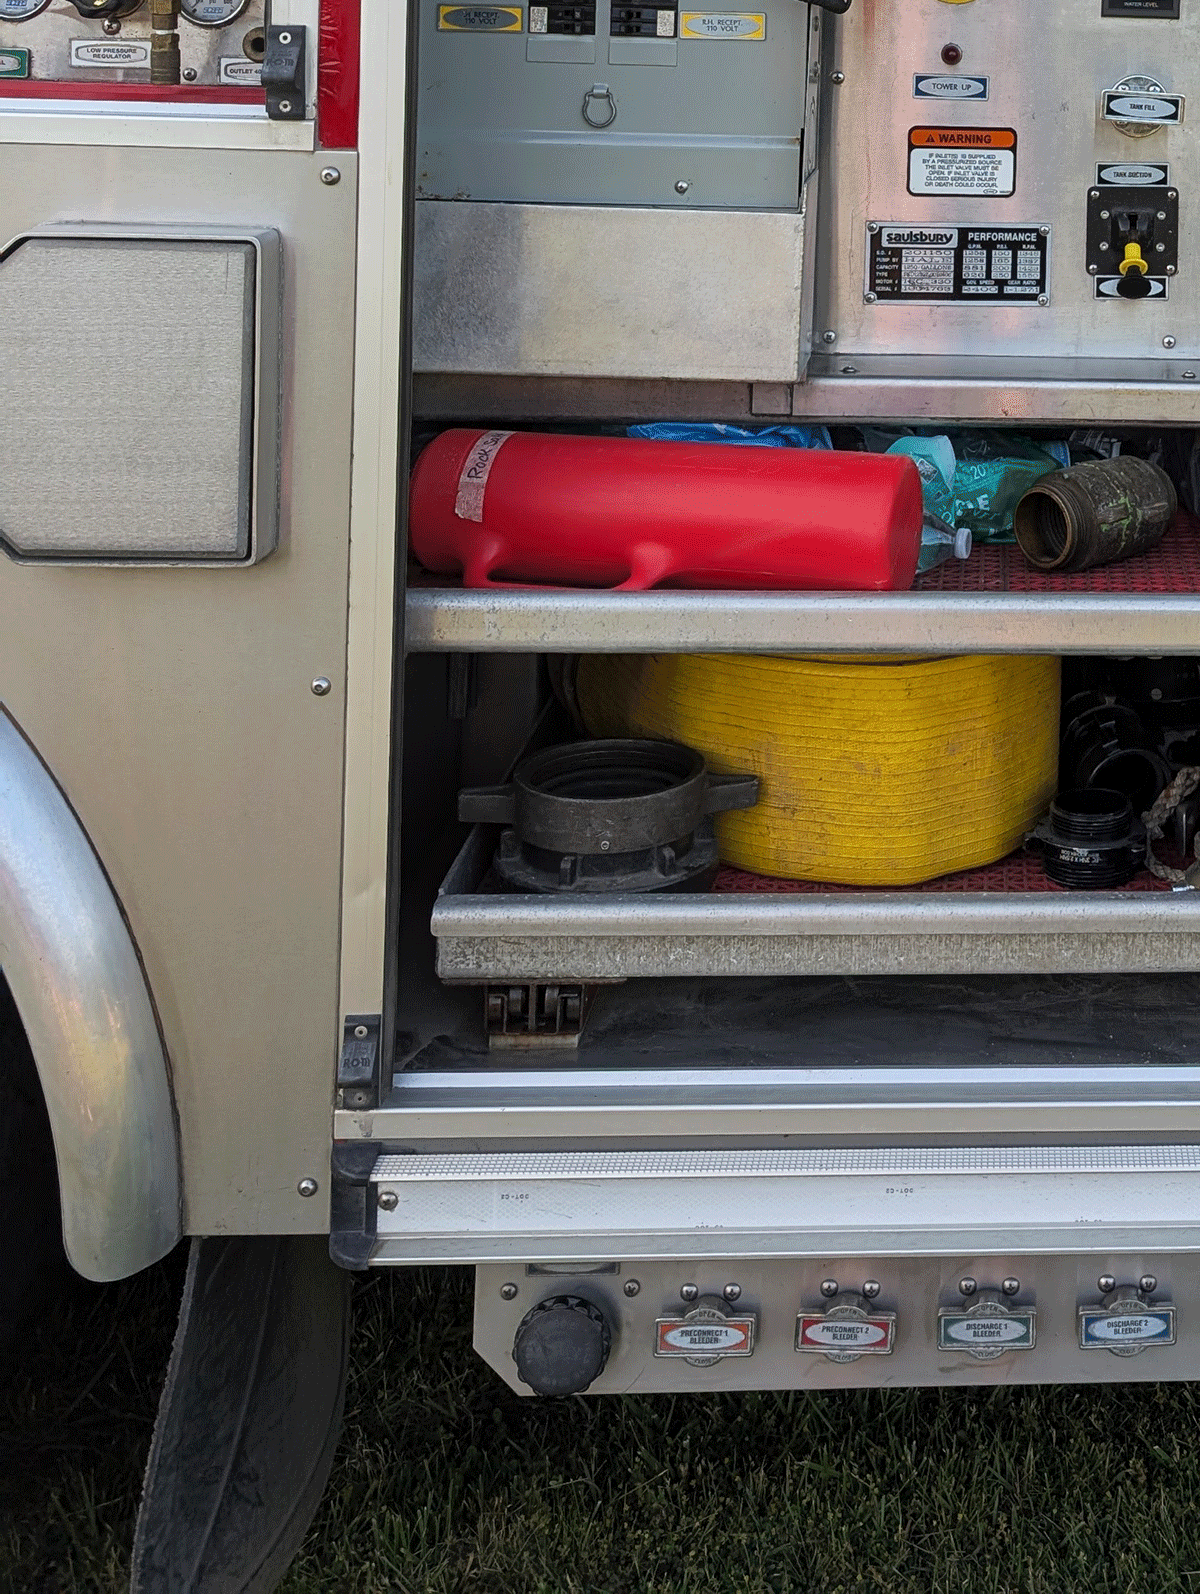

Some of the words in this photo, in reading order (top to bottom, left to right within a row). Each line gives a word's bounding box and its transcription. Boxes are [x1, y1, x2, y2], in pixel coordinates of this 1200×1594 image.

[932, 82, 958, 90] TOWER
[961, 83, 972, 91] UP
[938, 134, 992, 144] WARNING
[886, 230, 954, 245] saulsbury
[968, 232, 1038, 242] PERFORMANCE
[466, 448, 493, 479] Rock
[969, 465, 987, 481] 20
[966, 1322, 1002, 1332] DISCHARGE
[1106, 1320, 1142, 1329] DISCHARGE
[1143, 1319, 1149, 1327] 2
[680, 1329, 723, 1338] PRECONNECT
[821, 1325, 864, 1335] PRECONNECT
[864, 1326, 870, 1334] 2
[972, 1330, 1002, 1338] BLEEDER
[1113, 1326, 1143, 1336] BLEEDER
[689, 1336, 719, 1345] BLEEDER
[832, 1332, 858, 1341] BLEEDER
